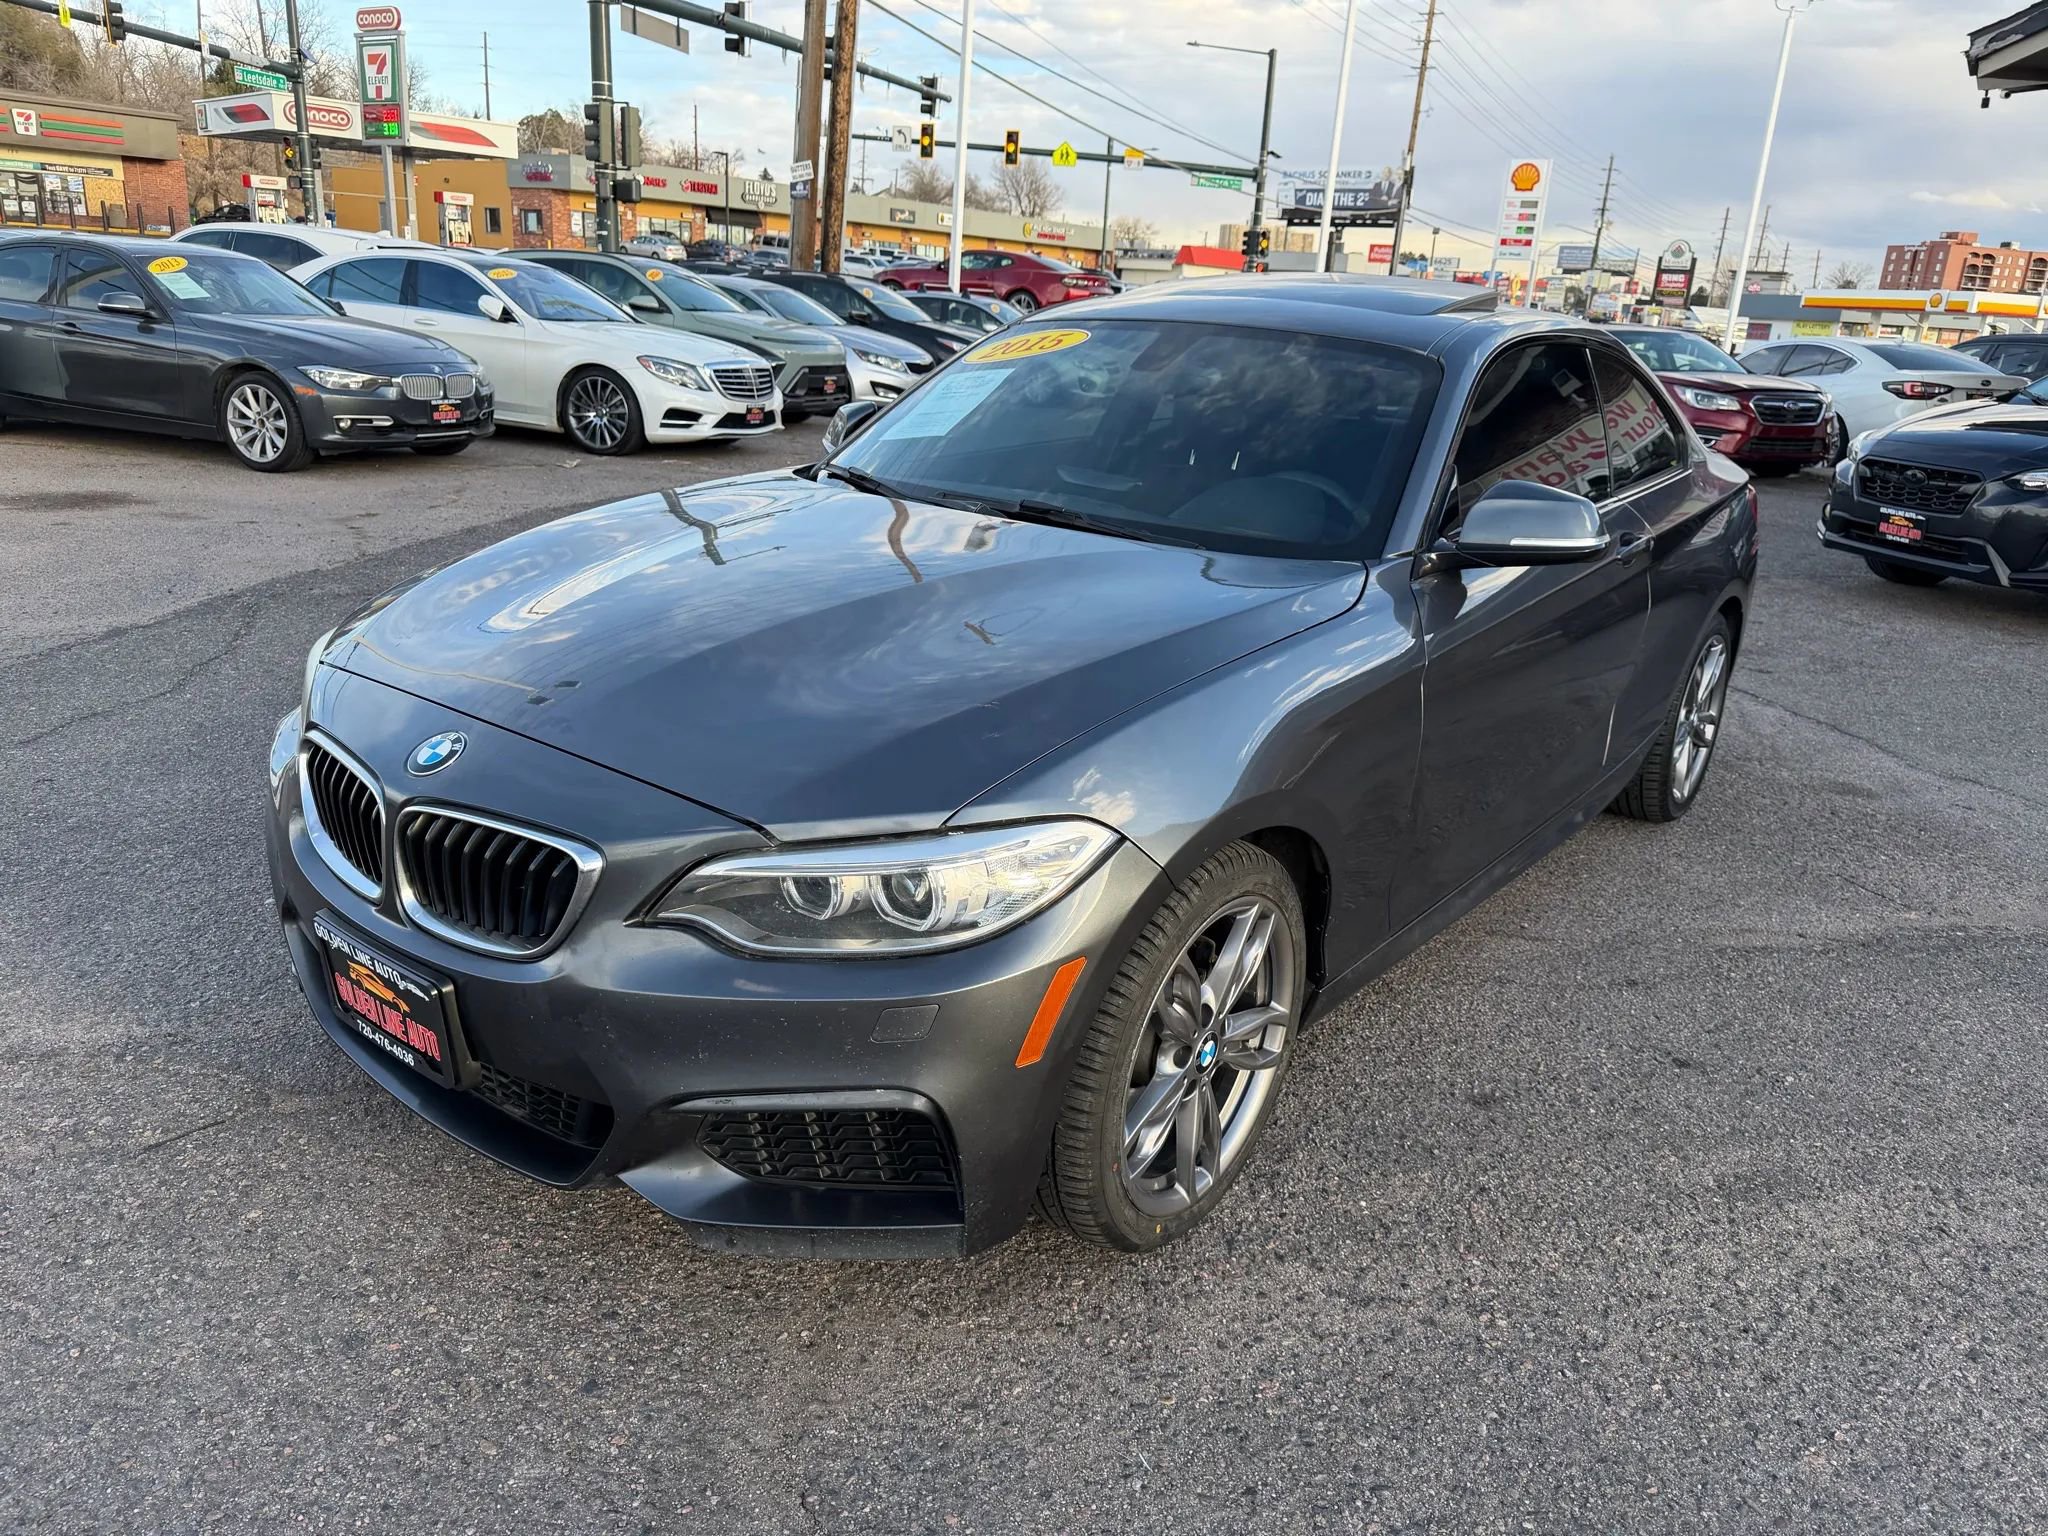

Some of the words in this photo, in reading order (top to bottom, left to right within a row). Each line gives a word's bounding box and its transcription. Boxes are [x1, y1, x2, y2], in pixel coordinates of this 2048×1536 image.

[243, 71, 277, 87] Leetsdale
[1318, 170, 1362, 180] SCANKER
[744, 180, 777, 197] FLOYD'S
[1306, 191, 1324, 207] DIA
[1334, 192, 1355, 206] THE
[155, 258, 181, 272] 2013
[979, 333, 1074, 360] 2015
[314, 922, 351, 956] GOLDEN
[350, 945, 374, 970] LINE
[374, 960, 402, 985] AUTO
[335, 972, 382, 1026] GOLDEN
[381, 1003, 408, 1043] LINE
[405, 1017, 441, 1062] AUTO
[357, 1019, 415, 1067] 720-476-4036
